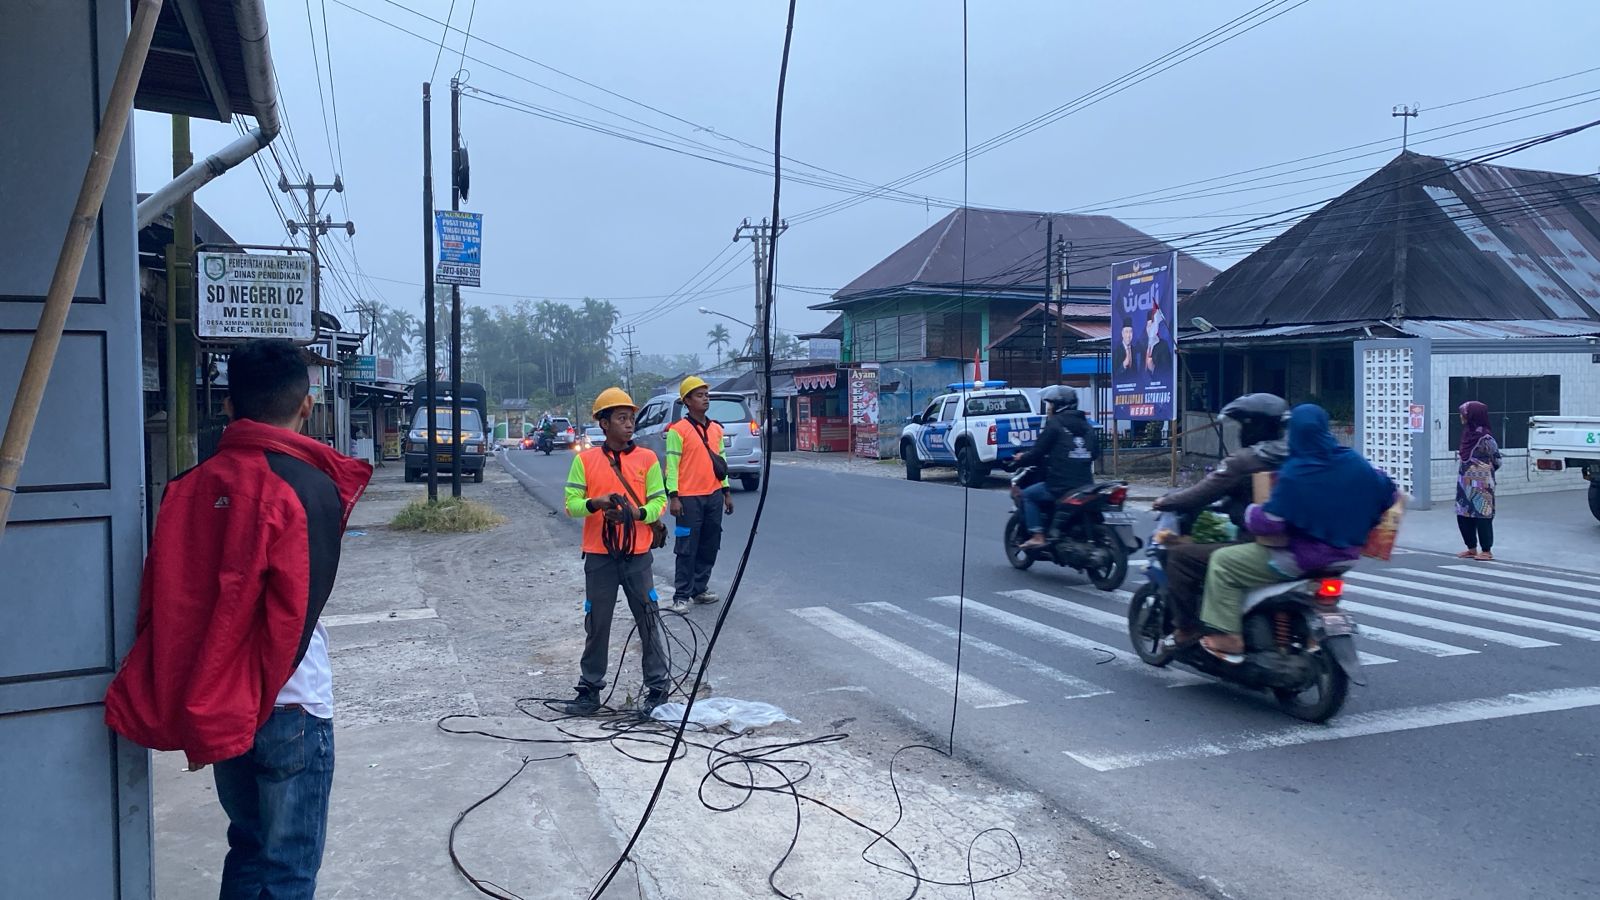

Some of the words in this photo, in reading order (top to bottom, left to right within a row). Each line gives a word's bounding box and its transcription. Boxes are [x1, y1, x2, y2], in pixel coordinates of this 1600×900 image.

[229, 258, 263, 269] PEMERINTAH
[277, 260, 306, 271] KEPAHIANG
[234, 270, 256, 279] DINAS
[258, 271, 301, 280] PENDIDIKAN
[207, 284, 225, 303] SD
[230, 285, 281, 305] NEGERI
[286, 287, 304, 305] 02
[223, 307, 289, 319] MERIGI
[851, 370, 876, 379] Ayam
[852, 381, 866, 424] GEPREK
[1586, 432, 1595, 444] &
